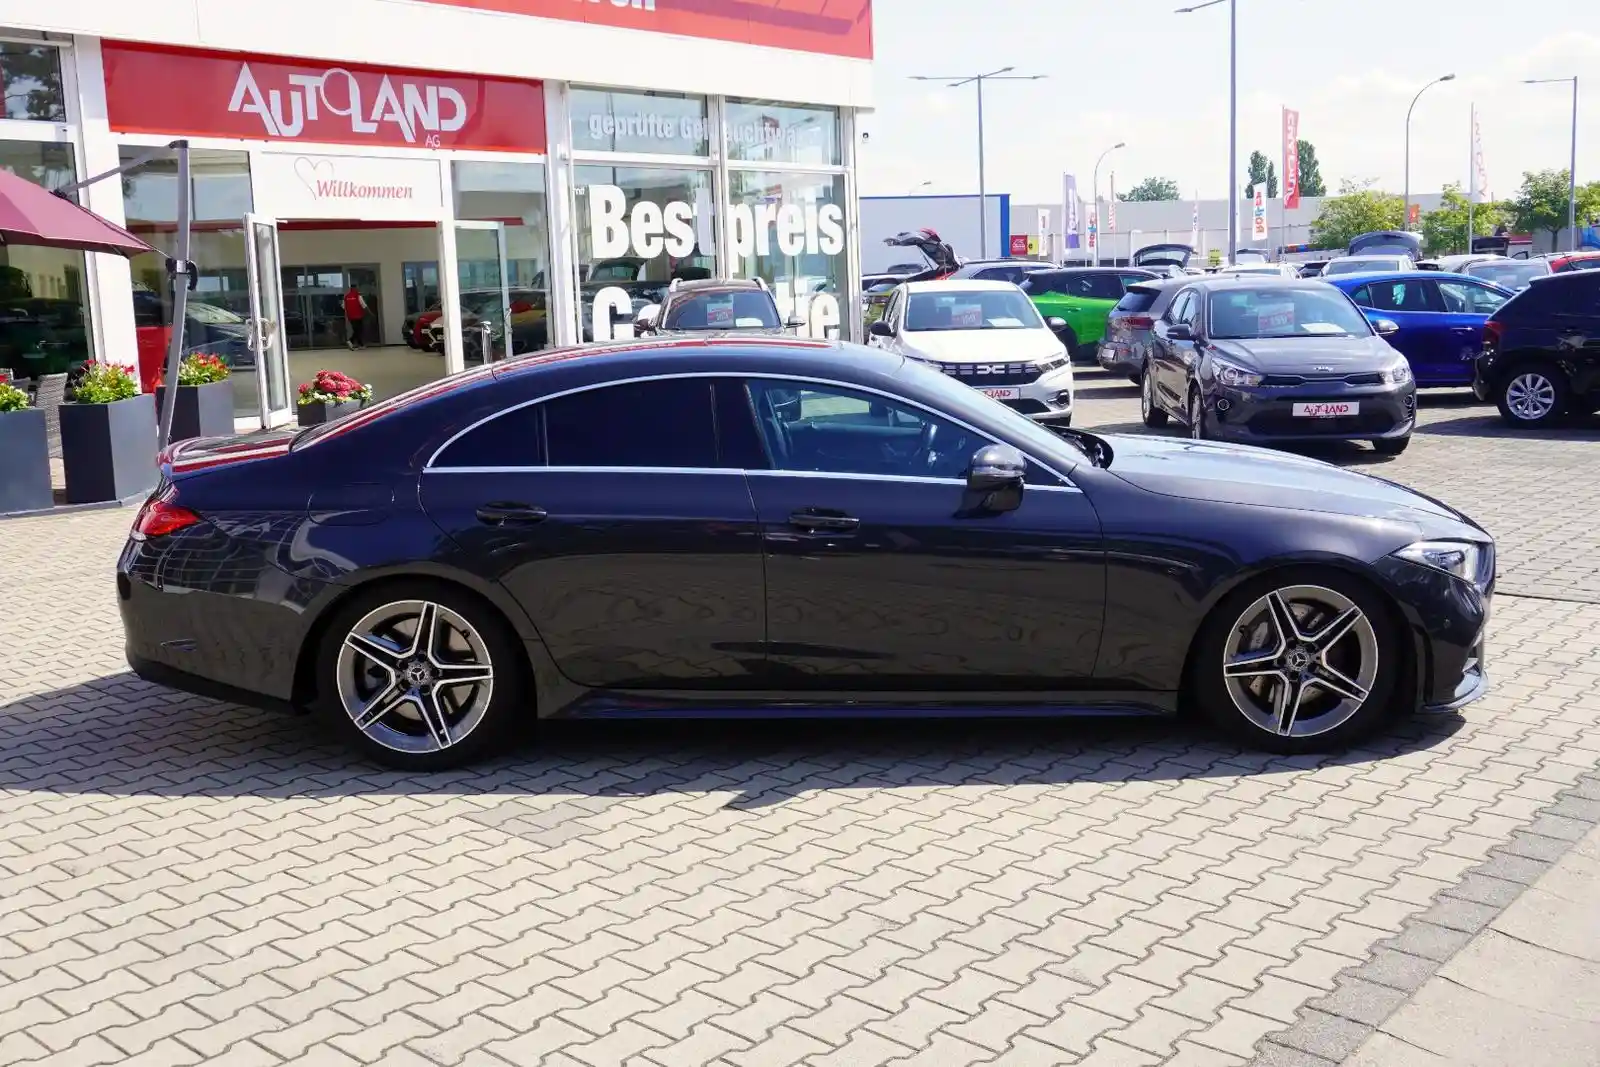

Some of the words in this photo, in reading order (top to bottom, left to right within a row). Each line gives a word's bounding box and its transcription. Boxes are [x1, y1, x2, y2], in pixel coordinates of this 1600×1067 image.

[228, 61, 467, 143] AUTOLAND
[588, 111, 673, 141] geprüfte
[425, 134, 441, 148] AG
[316, 179, 413, 199] Willkommen
